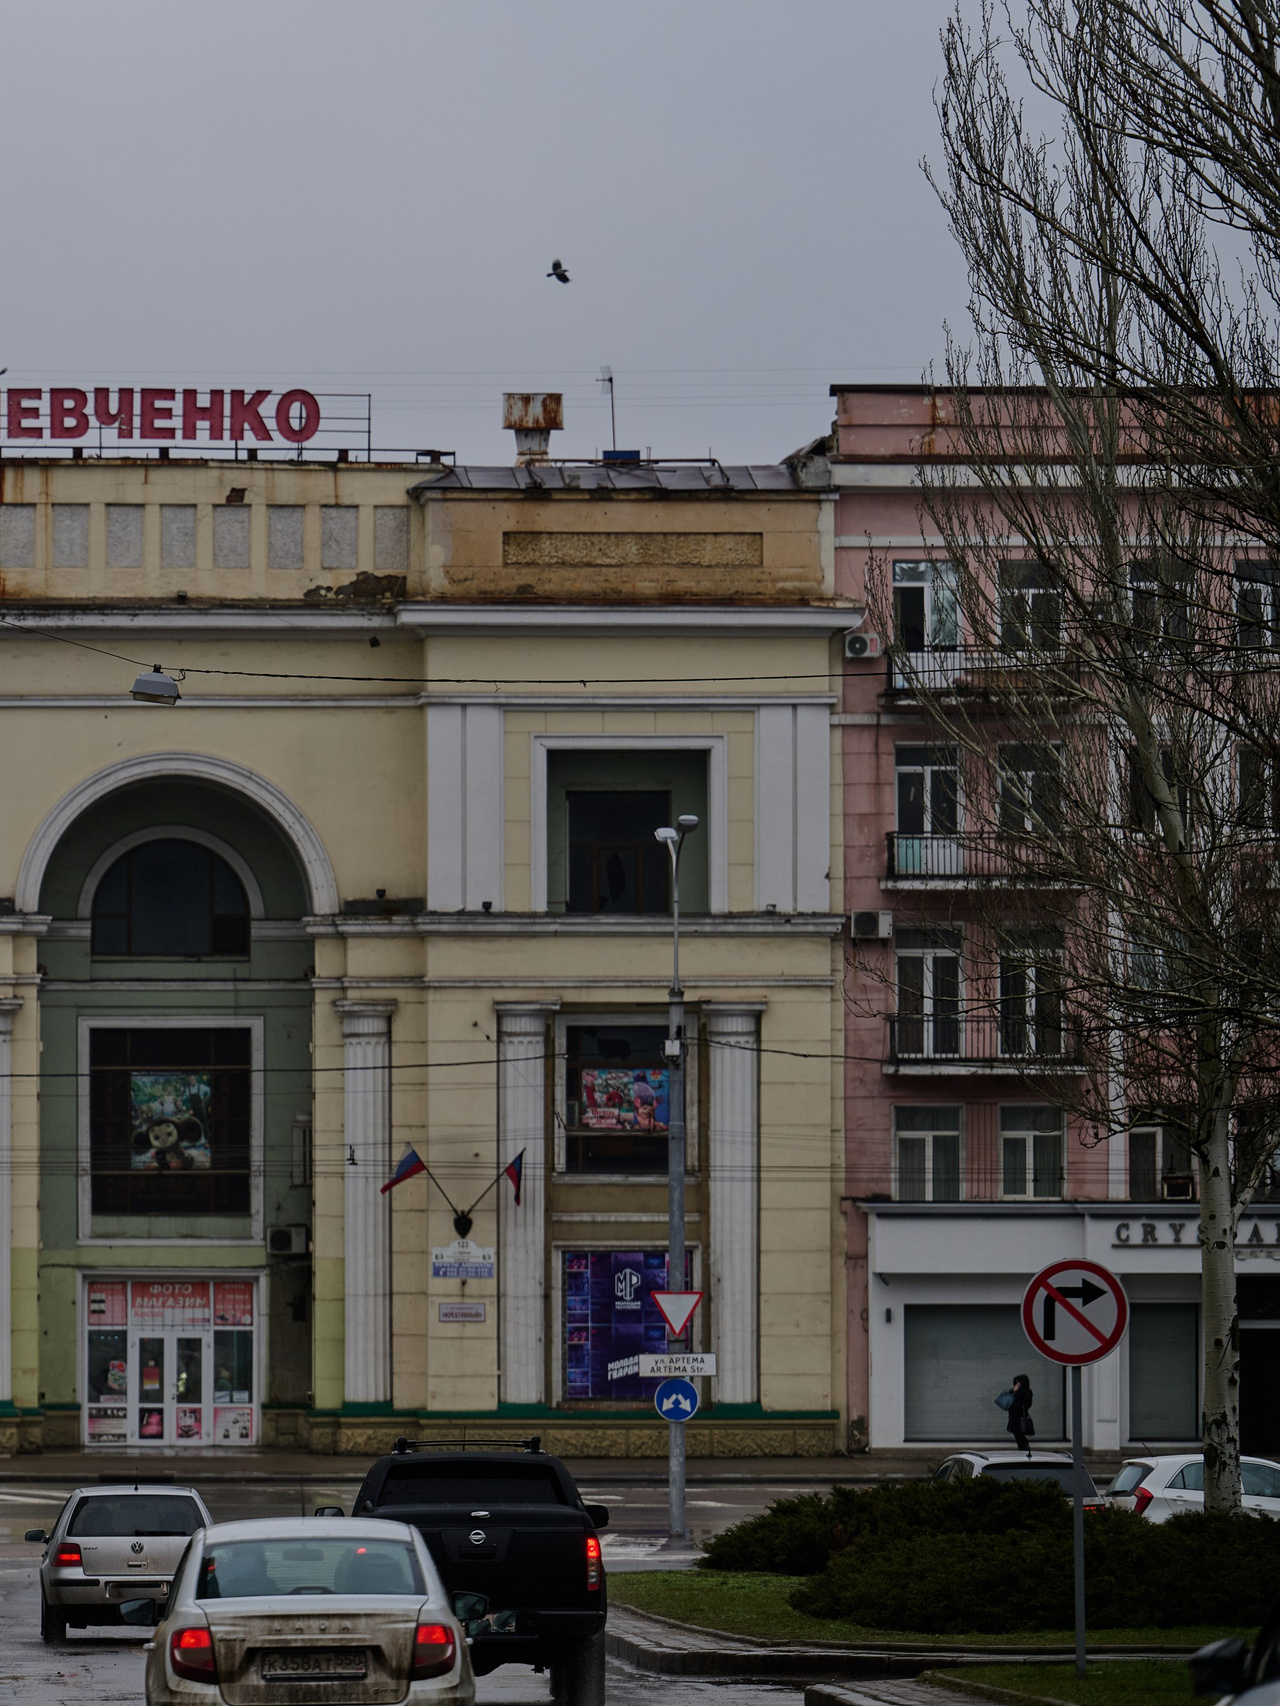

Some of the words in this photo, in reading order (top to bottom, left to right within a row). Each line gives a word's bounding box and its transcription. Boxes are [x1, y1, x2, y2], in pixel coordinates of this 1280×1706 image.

[149, 1284, 193, 1294] ФОТО
[135, 1297, 206, 1308] МАГАЗИН
[608, 1355, 638, 1371] МОЛОДА
